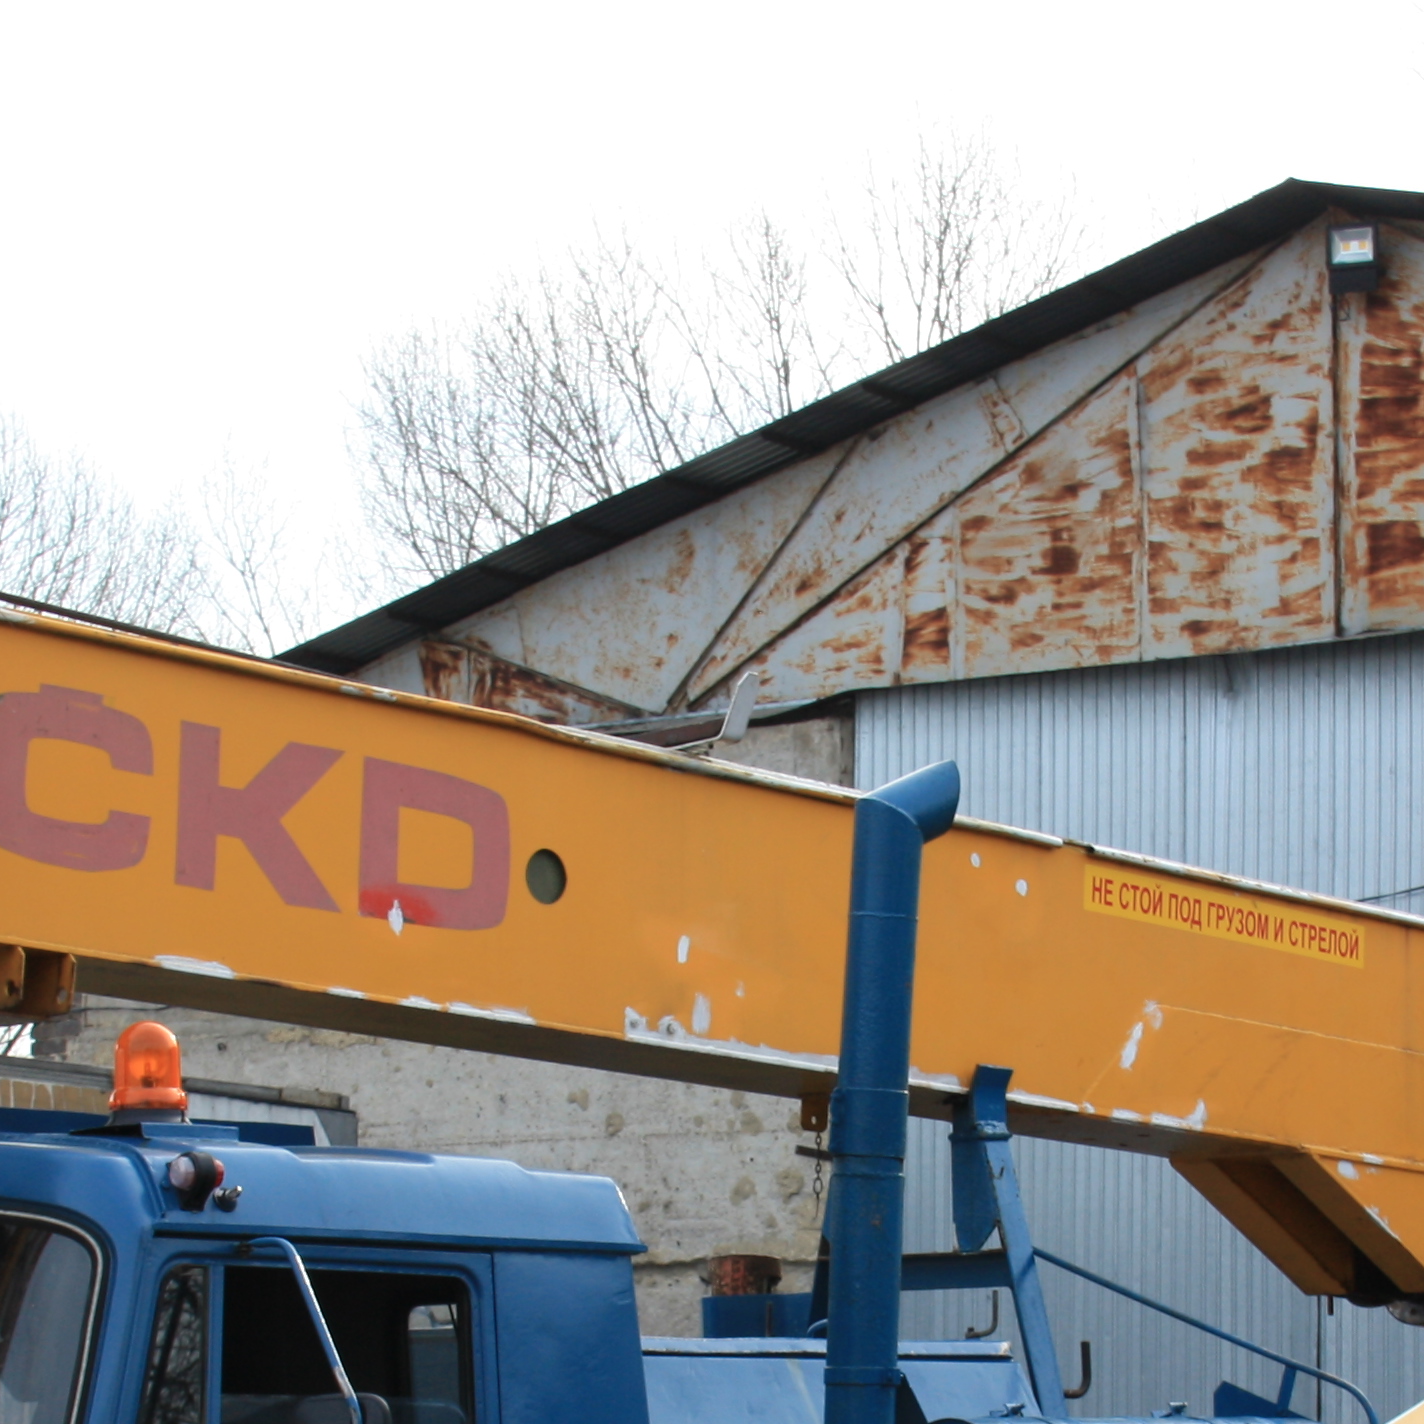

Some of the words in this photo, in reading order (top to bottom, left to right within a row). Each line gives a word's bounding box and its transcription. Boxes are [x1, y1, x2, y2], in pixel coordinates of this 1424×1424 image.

[1092, 876, 1114, 907] НЕ
[1119, 882, 1164, 918] СТОЙ
[1168, 893, 1202, 931] ПОД
[1207, 902, 1270, 940] ГРУЗОМ
[1274, 916, 1284, 943] И
[1289, 920, 1359, 960] СТРЕЛОЙ
